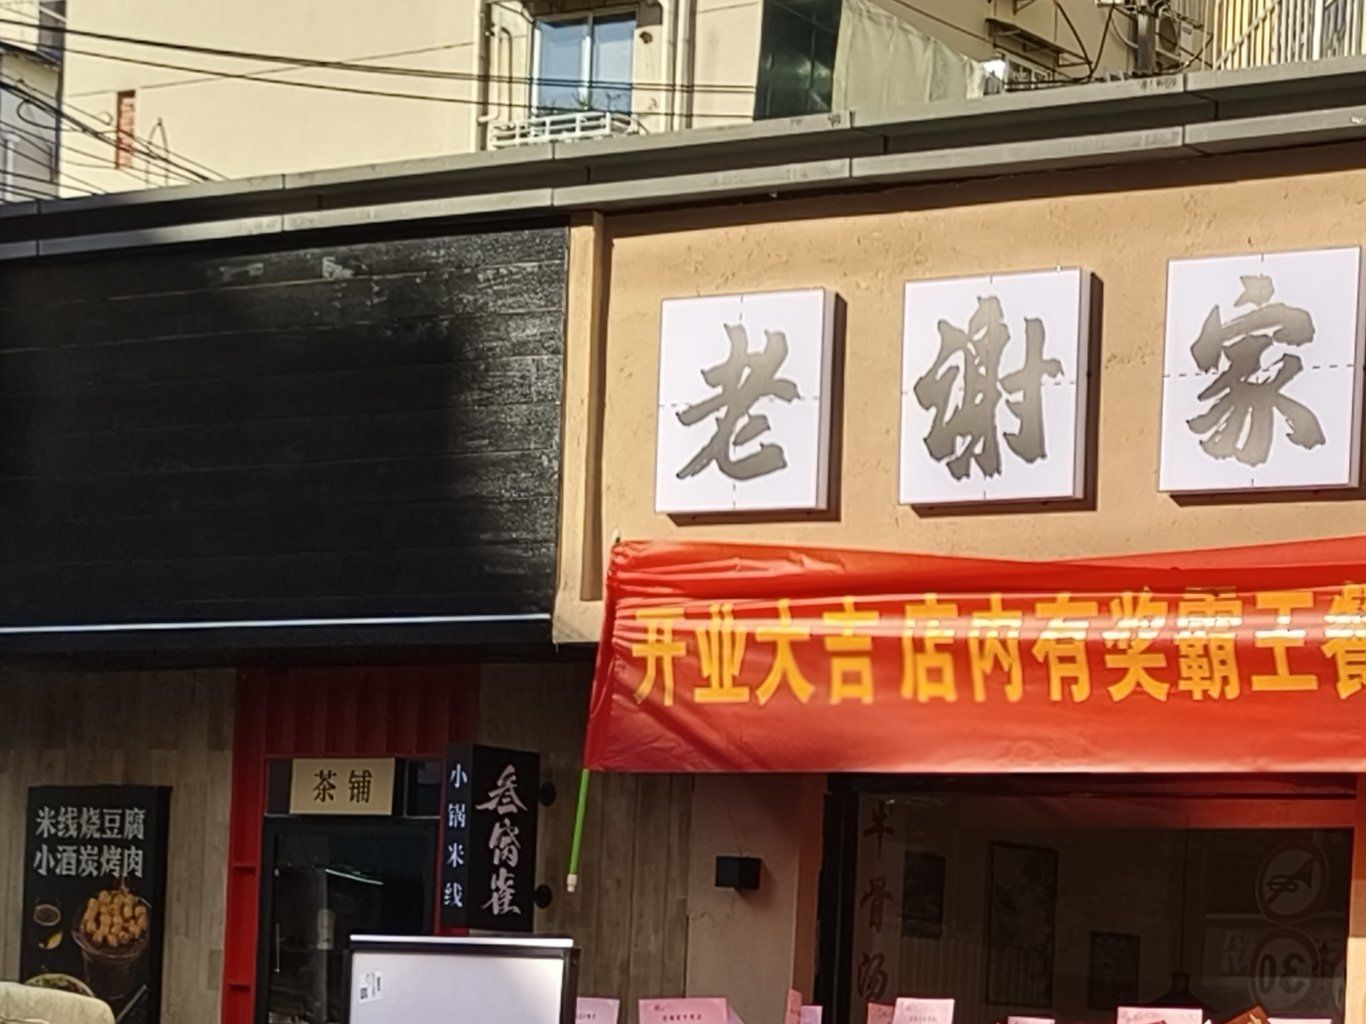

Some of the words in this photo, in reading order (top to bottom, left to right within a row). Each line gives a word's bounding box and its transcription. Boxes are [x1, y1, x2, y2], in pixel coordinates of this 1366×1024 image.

[631, 597, 880, 706] 开业大吉
[312, 769, 374, 804] 茶铺
[36, 806, 146, 839] 米线烧豆腐
[444, 763, 468, 908] 小锅米线
[33, 844, 144, 878] 小酒炭烤肉
